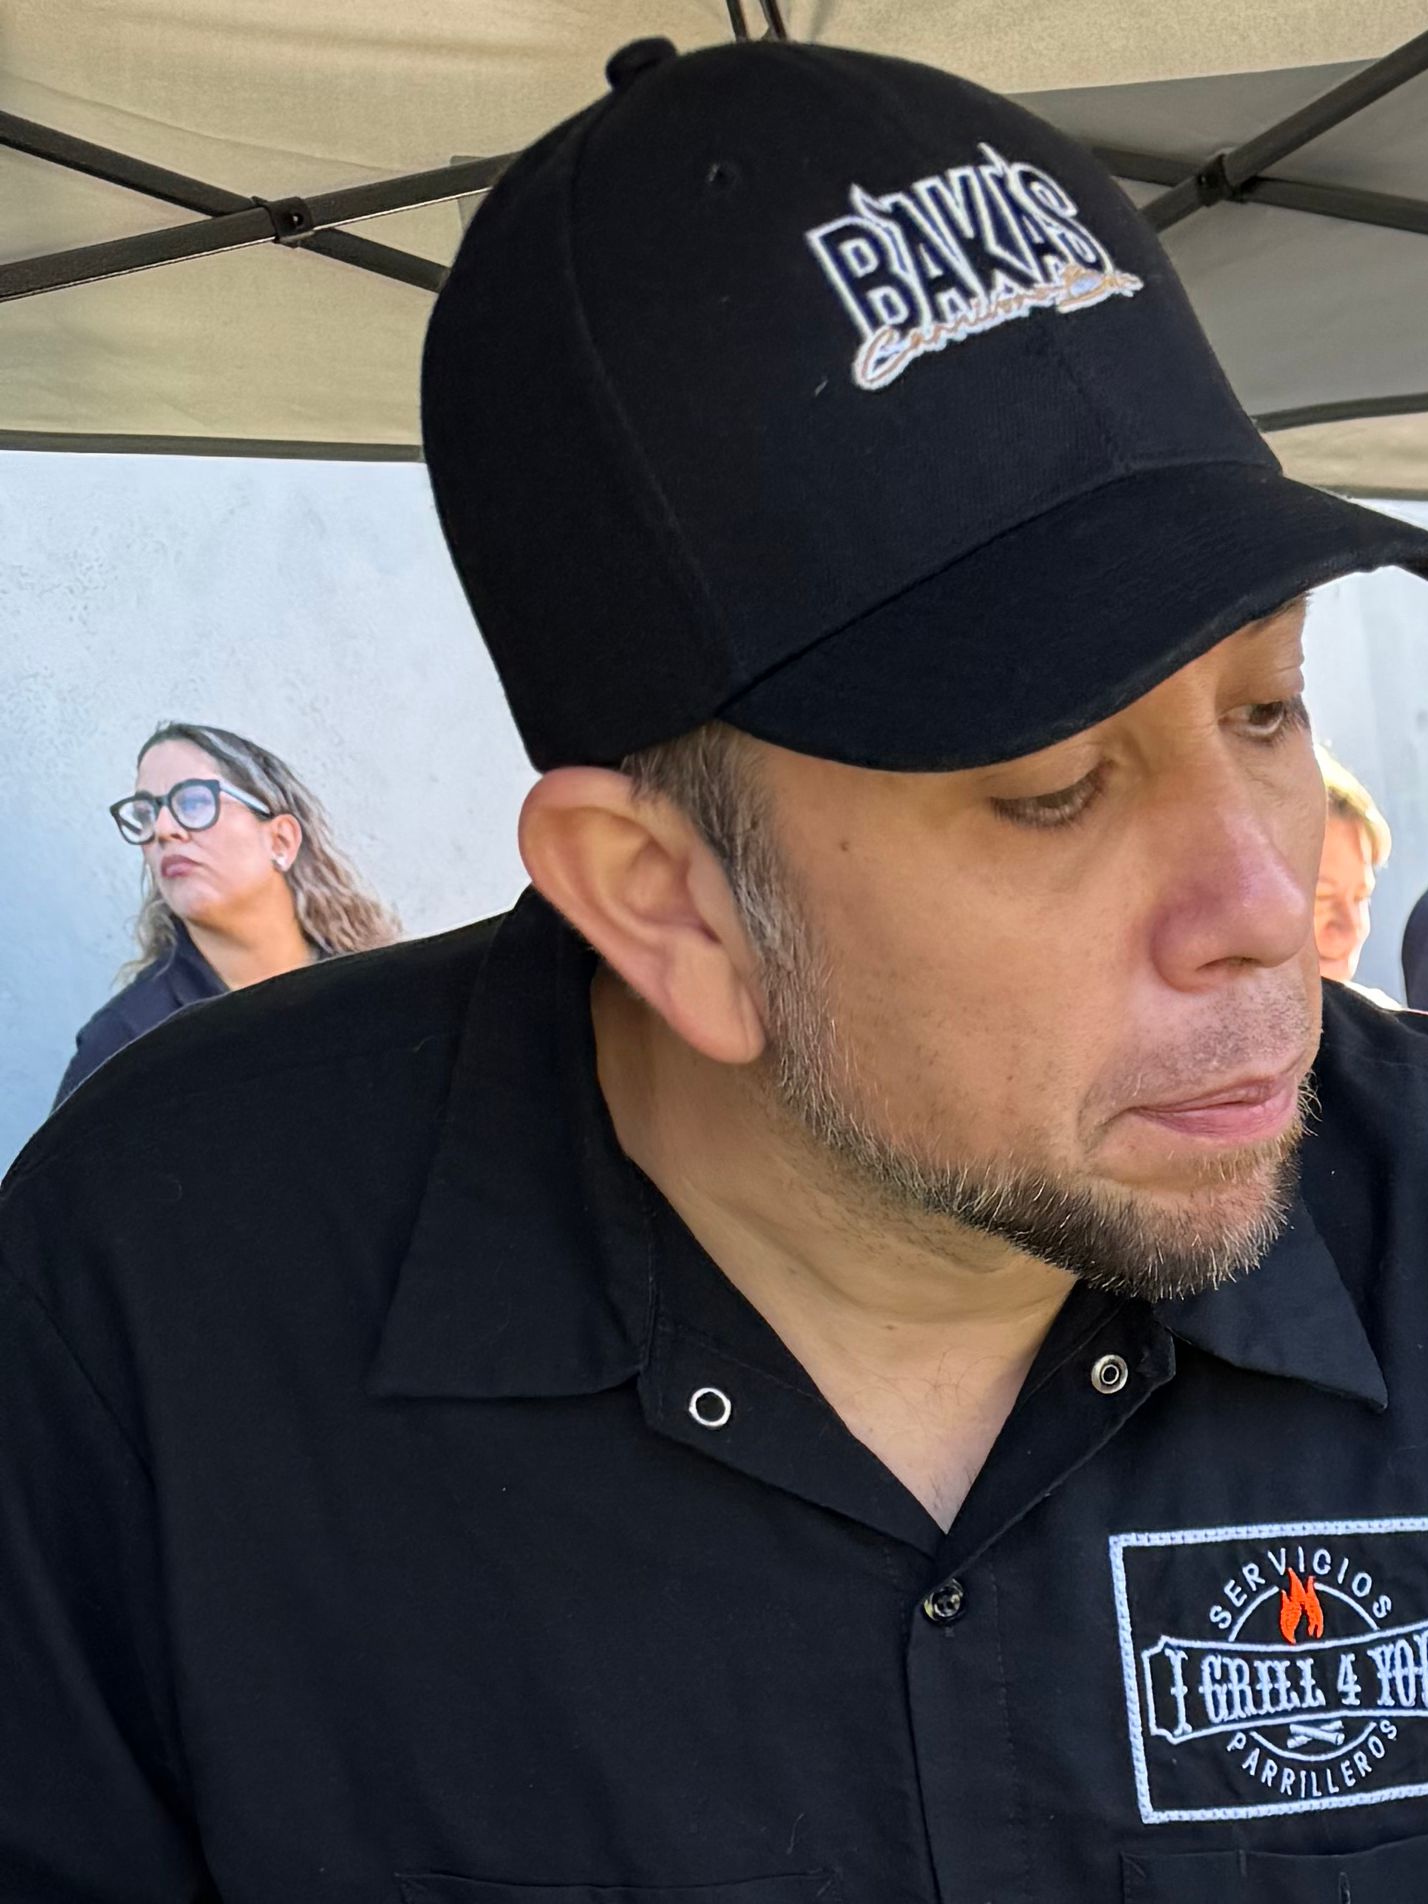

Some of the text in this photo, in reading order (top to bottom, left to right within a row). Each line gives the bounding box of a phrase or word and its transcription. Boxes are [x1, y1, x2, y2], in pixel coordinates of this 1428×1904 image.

[1209, 1546, 1392, 1630] SERVICIOS
[1164, 1648, 1193, 1736] I
[1199, 1652, 1327, 1725] GRILL
[1337, 1652, 1362, 1707] 4
[1226, 1719, 1398, 1798] PARRILLEROS
